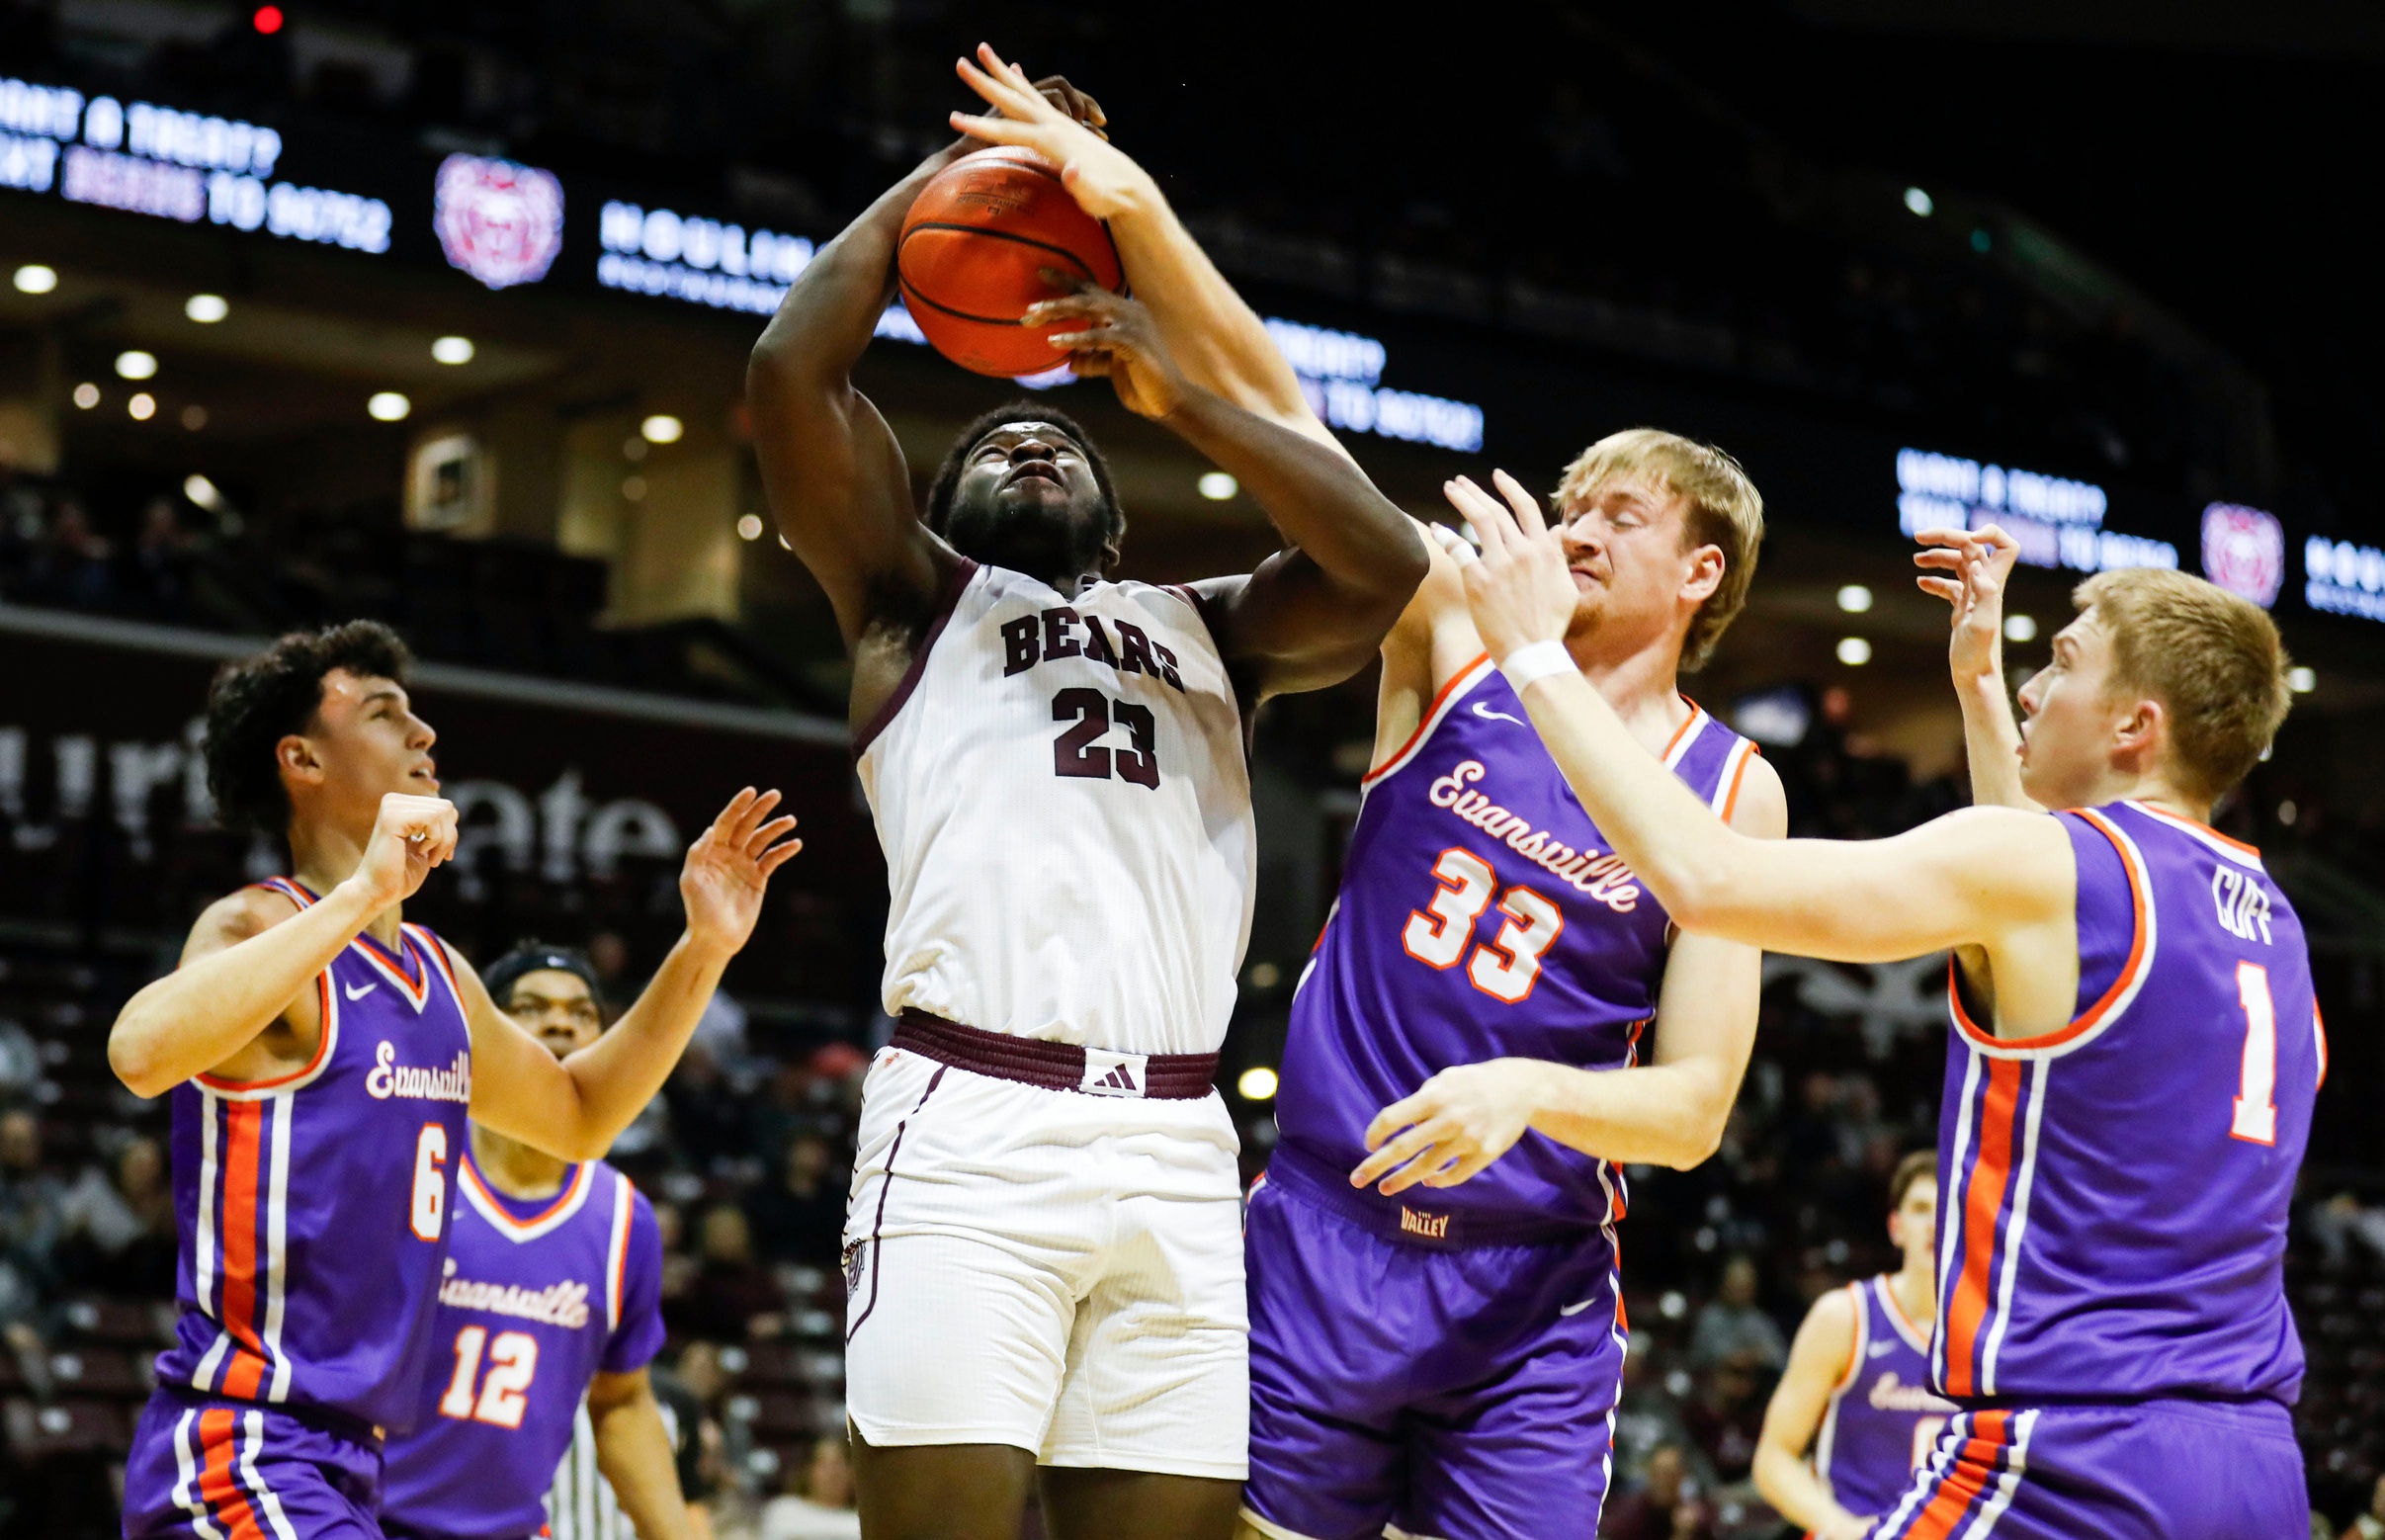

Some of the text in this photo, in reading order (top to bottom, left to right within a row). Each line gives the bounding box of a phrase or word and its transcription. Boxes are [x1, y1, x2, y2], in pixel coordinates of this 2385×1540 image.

[1000, 606, 1186, 695] BEARS
[1052, 687, 1161, 792] 23
[1429, 760, 1641, 912] Evansville
[1401, 845, 1565, 1005] 33
[2211, 863, 2273, 946] CUFF
[366, 1040, 471, 1104] Evansvill
[2228, 959, 2279, 1148] 1
[409, 1122, 448, 1242] 6
[1401, 1205, 1450, 1239] VALLEY
[438, 1324, 540, 1430] 12
